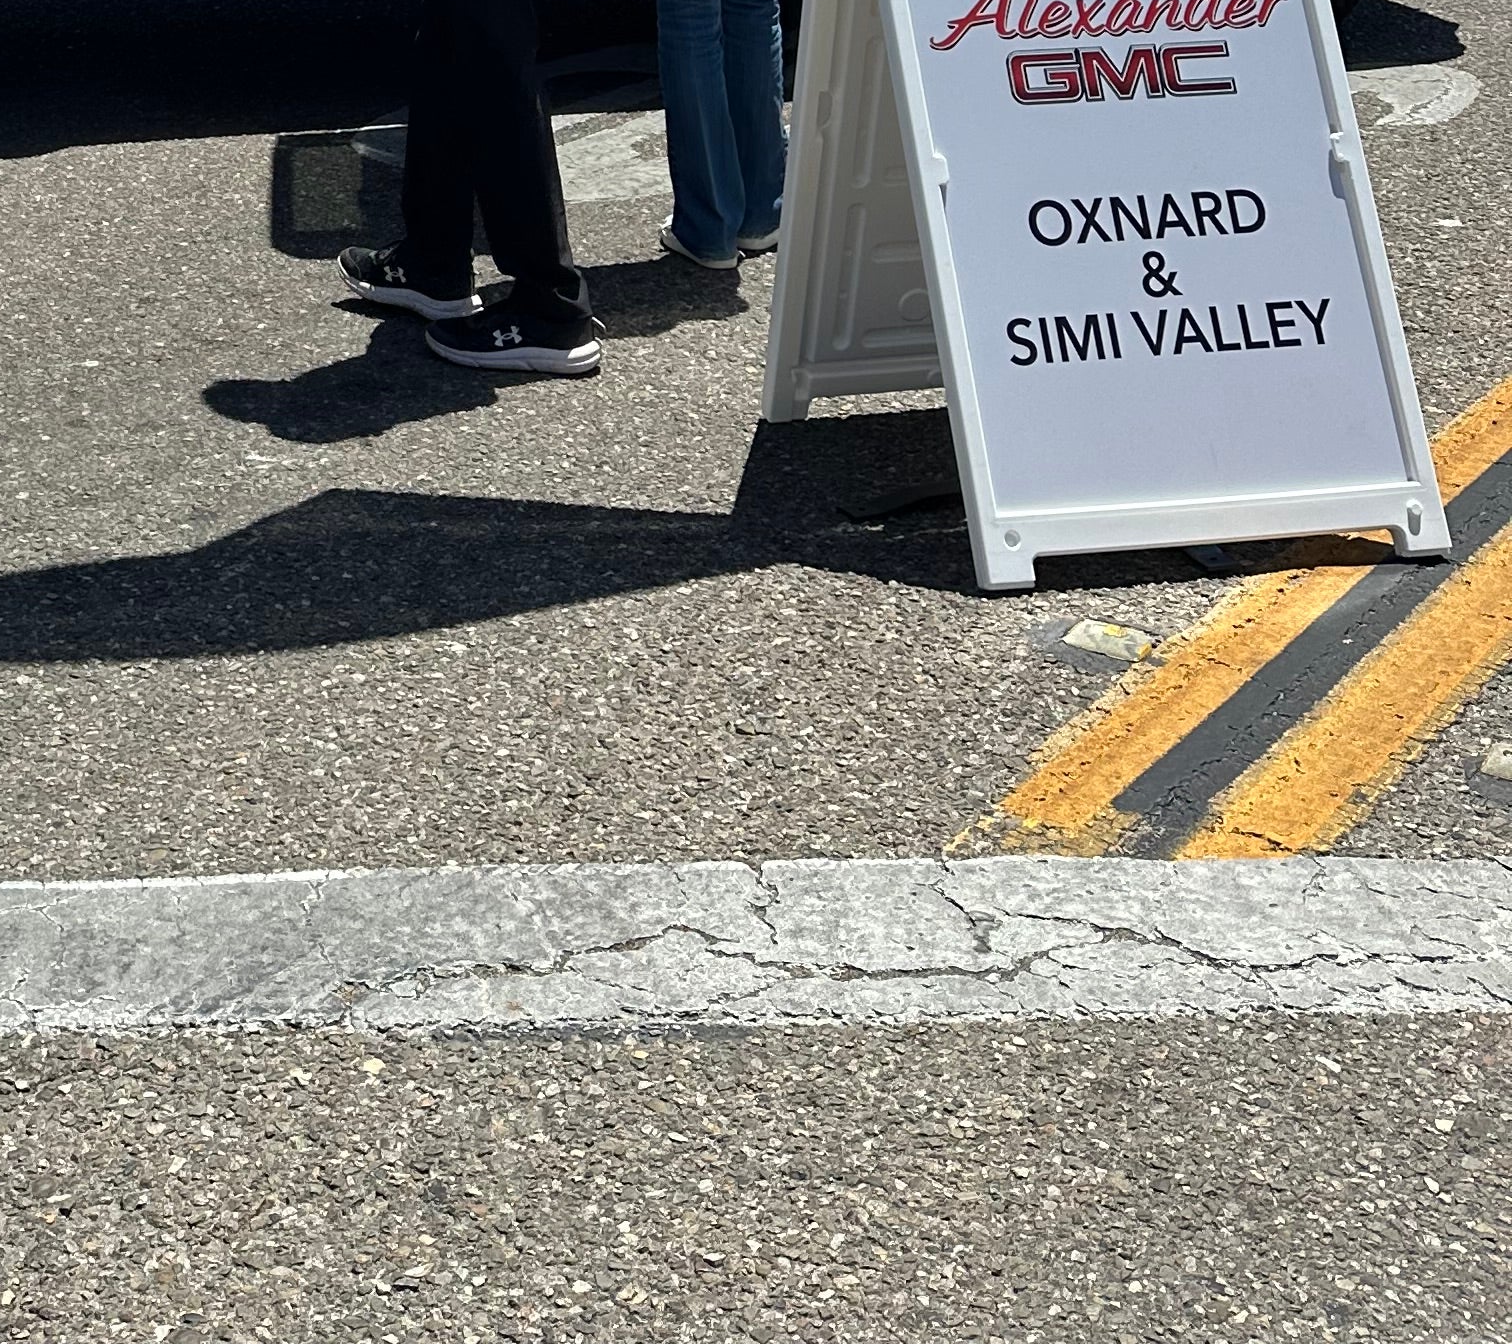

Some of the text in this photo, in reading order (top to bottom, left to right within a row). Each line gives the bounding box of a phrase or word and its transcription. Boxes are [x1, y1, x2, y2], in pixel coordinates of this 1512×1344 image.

[1006, 40, 1237, 105] GMC
[1028, 189, 1266, 247] OXNARD
[1141, 250, 1183, 298] &
[1006, 298, 1330, 366] SIMI VALLEY
